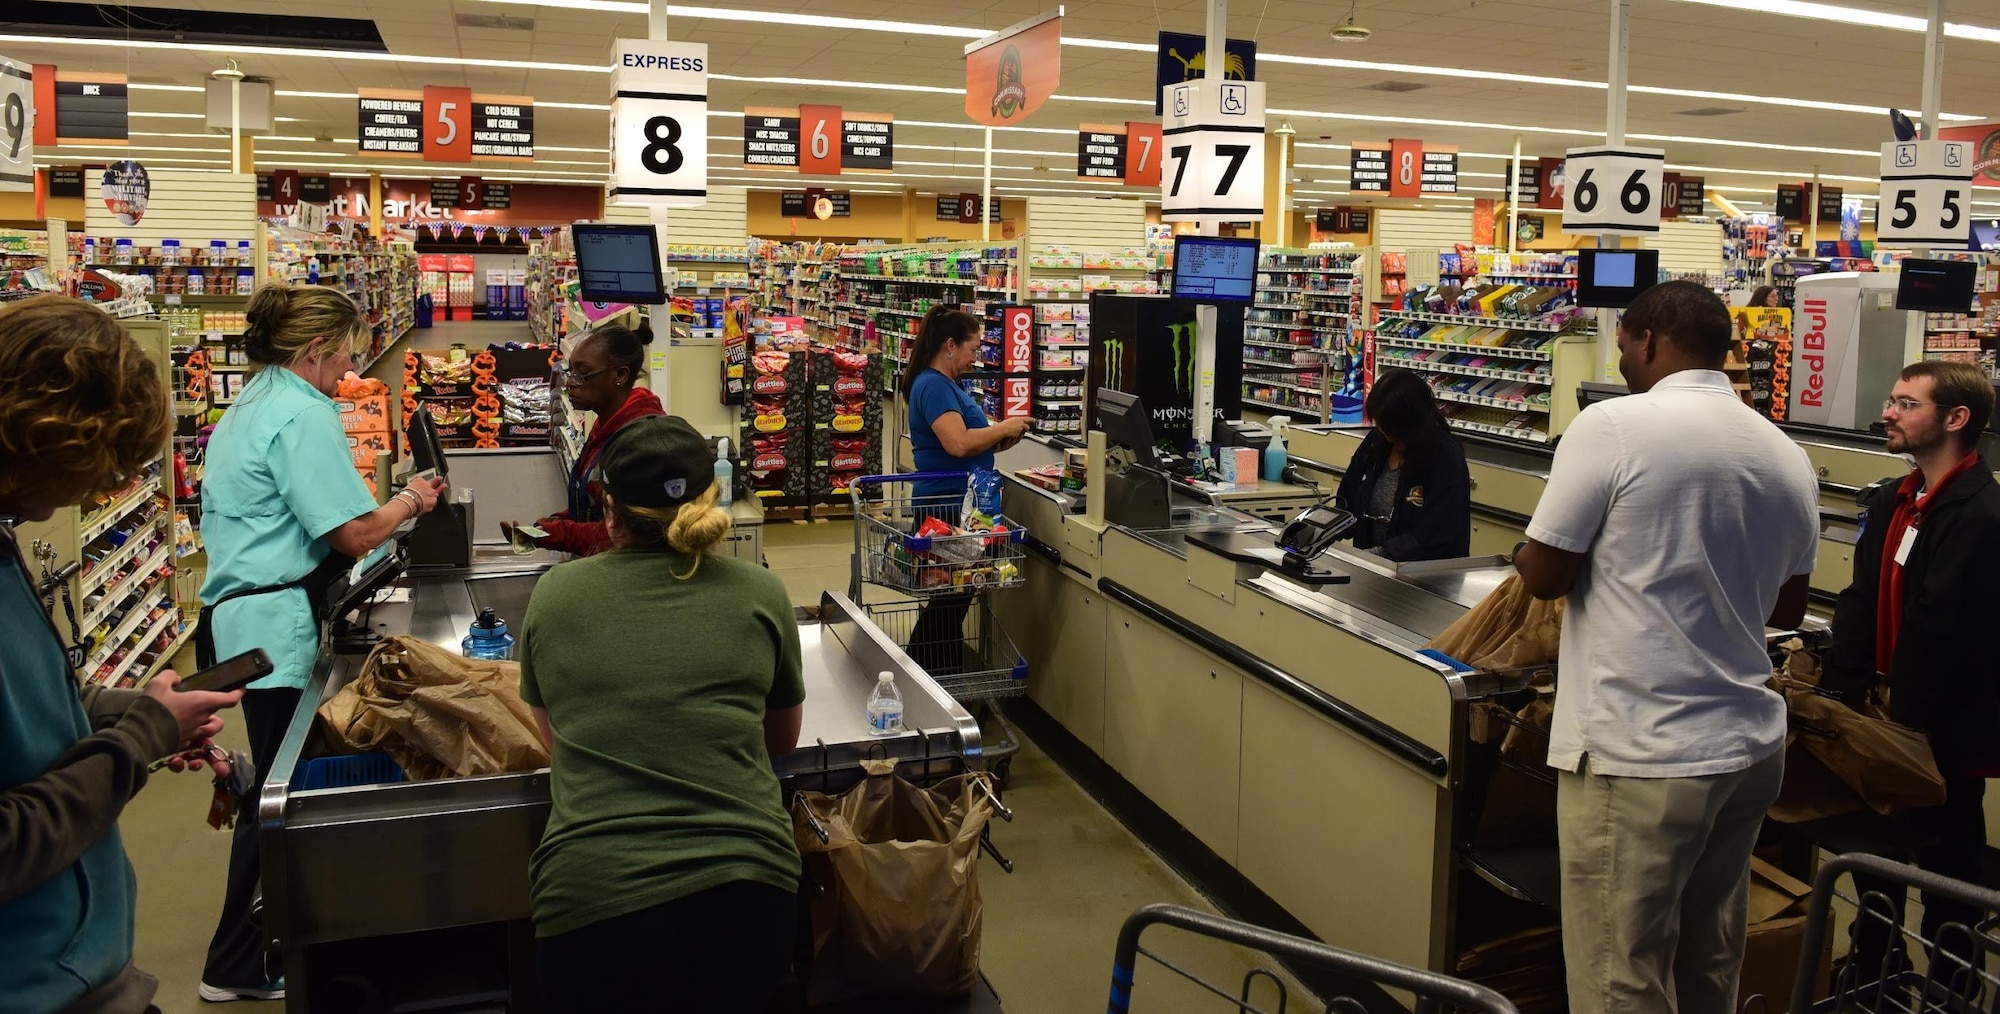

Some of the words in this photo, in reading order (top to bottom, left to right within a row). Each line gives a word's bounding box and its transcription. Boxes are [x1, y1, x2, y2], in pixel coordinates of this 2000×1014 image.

[623, 53, 703, 72] EXPRESS
[83, 85, 100, 95] JUICE
[361, 100, 392, 111] POWDERED
[393, 102, 421, 112] BEVERAGE
[485, 106, 500, 116] COLD
[500, 107, 520, 117] CEREAL
[375, 114, 408, 124] COFFEE/TEA
[436, 102, 457, 145] 5
[487, 119, 498, 129] HOT
[498, 120, 518, 130] CEREAL
[764, 118, 781, 127] CANDY
[5, 92, 25, 158] 9
[845, 122, 857, 132] SOFT
[857, 123, 888, 133] DRINKS/SODA
[365, 127, 418, 138] CREAMERS/FILTERS
[474, 132, 500, 142] PANCAKE
[500, 133, 531, 143] MIX/SYRUP
[756, 131, 768, 139] MISC
[768, 131, 789, 140] SNACKS
[811, 119, 829, 159] 6
[847, 134, 887, 145] CONES/TOPPINGS
[1090, 134, 1115, 143] BEVERAGES
[363, 140, 387, 151] INSTANT
[388, 141, 419, 152] BREAKFAST
[641, 115, 684, 175] 8
[749, 142, 765, 151] SNACK
[766, 143, 795, 153] NUTS/SEEDS
[1086, 145, 1104, 154] BOTTLED
[1104, 146, 1119, 155] WATER
[518, 146, 533, 156] BARS
[853, 146, 864, 156] RICE
[865, 147, 881, 157] CAKES
[1138, 135, 1153, 172] 7
[748, 154, 795, 165] COOKIES/CRACKERS
[1091, 156, 1102, 165] BABY
[1103, 157, 1114, 165] FOOD
[1086, 168, 1098, 176] BABY
[1098, 168, 1117, 177] FORMULA
[1171, 145, 1192, 197] 7
[1214, 145, 1251, 196] 7
[1400, 151, 1413, 185] 8
[112, 185, 146, 194] MILITARY
[281, 177, 292, 198] 4
[465, 183, 476, 203] 5
[1574, 168, 1598, 213] 6
[1621, 169, 1650, 214] 6
[965, 199, 974, 218] 8
[1891, 190, 1916, 229] 5
[1940, 190, 1960, 229] 5
[1803, 300, 1827, 350] Bull
[756, 379, 785, 390] Skittles
[837, 380, 864, 390] Skittles
[1800, 355, 1824, 407] Red
[432, 385, 458, 395] Twix
[1153, 406, 1225, 421] MONSR
[756, 416, 785, 426] Starburst
[834, 416, 863, 427] Starburst
[756, 458, 785, 467] Skittles
[834, 457, 862, 467] Skittles
